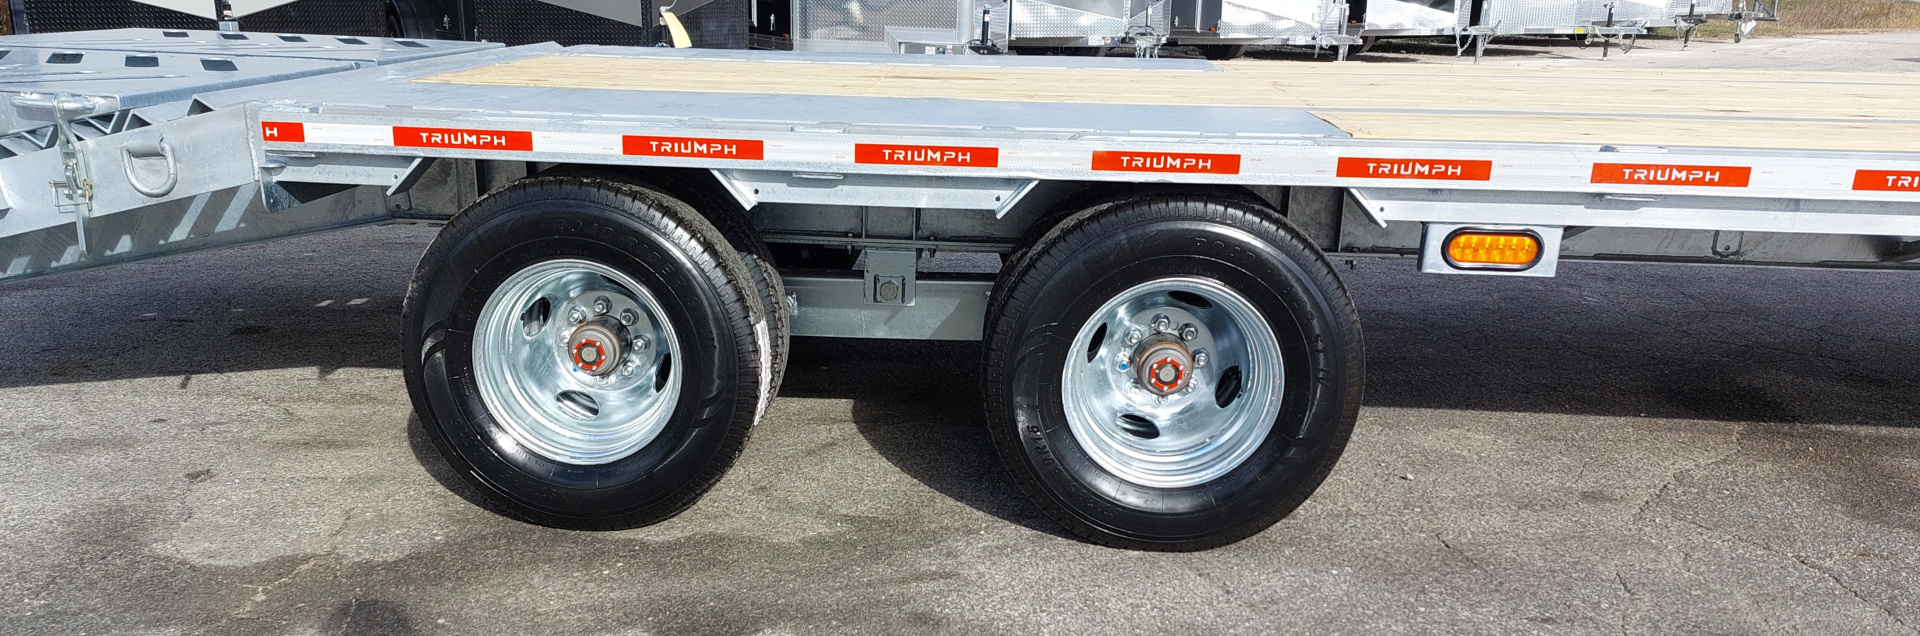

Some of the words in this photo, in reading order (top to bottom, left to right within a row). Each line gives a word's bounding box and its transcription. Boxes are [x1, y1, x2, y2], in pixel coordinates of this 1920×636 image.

[419, 131, 506, 147] TRIUMPH
[649, 140, 737, 156] TRIUMPH
[882, 148, 971, 163] TRIUMPH
[1120, 155, 1212, 170] TRIUMPH
[1366, 161, 1462, 176] TRIUMPH
[1622, 167, 1720, 183] TRIUMPH
